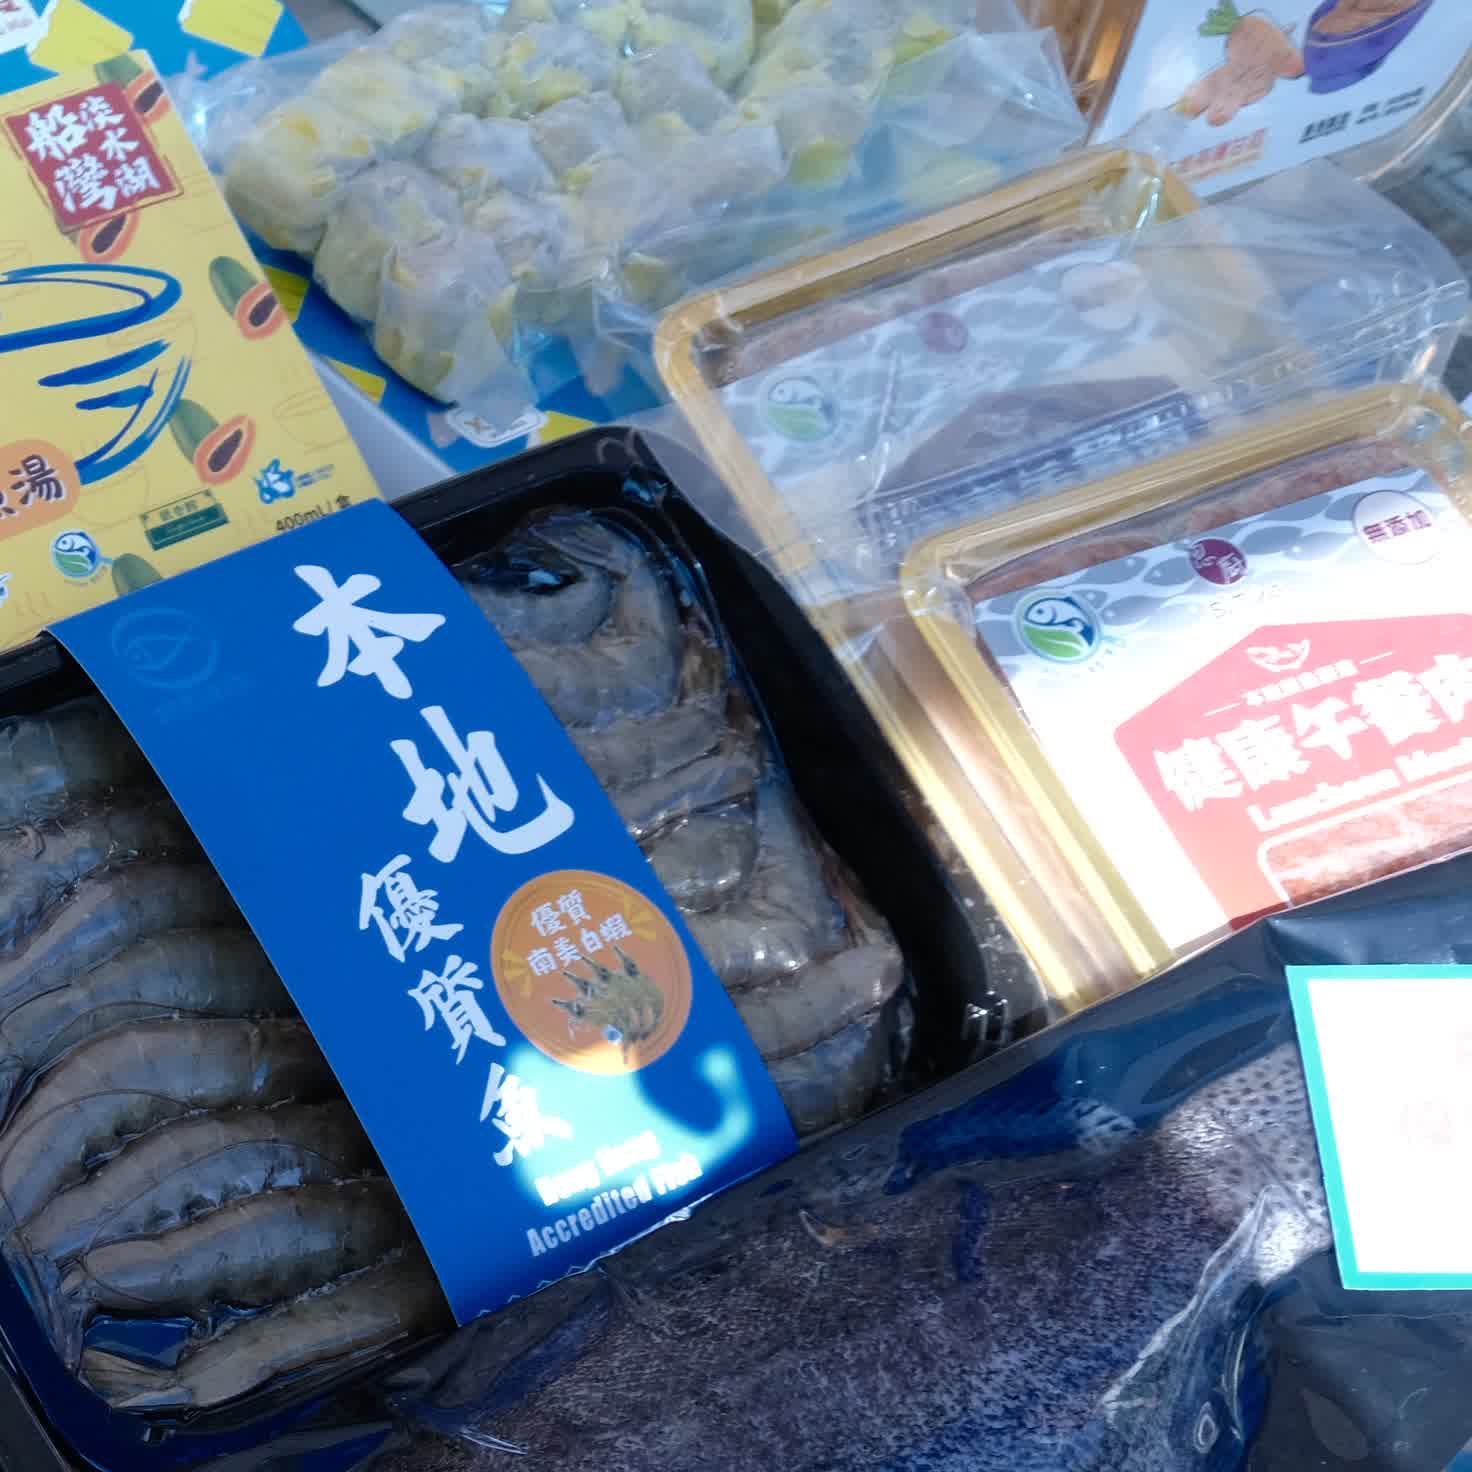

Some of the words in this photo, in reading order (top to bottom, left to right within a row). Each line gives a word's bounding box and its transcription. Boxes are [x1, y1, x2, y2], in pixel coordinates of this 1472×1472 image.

[294, 565, 576, 863] 本地
[527, 914, 633, 977] 南美白蝦
[530, 889, 592, 937] 優質
[527, 1174, 653, 1257] Accredited
